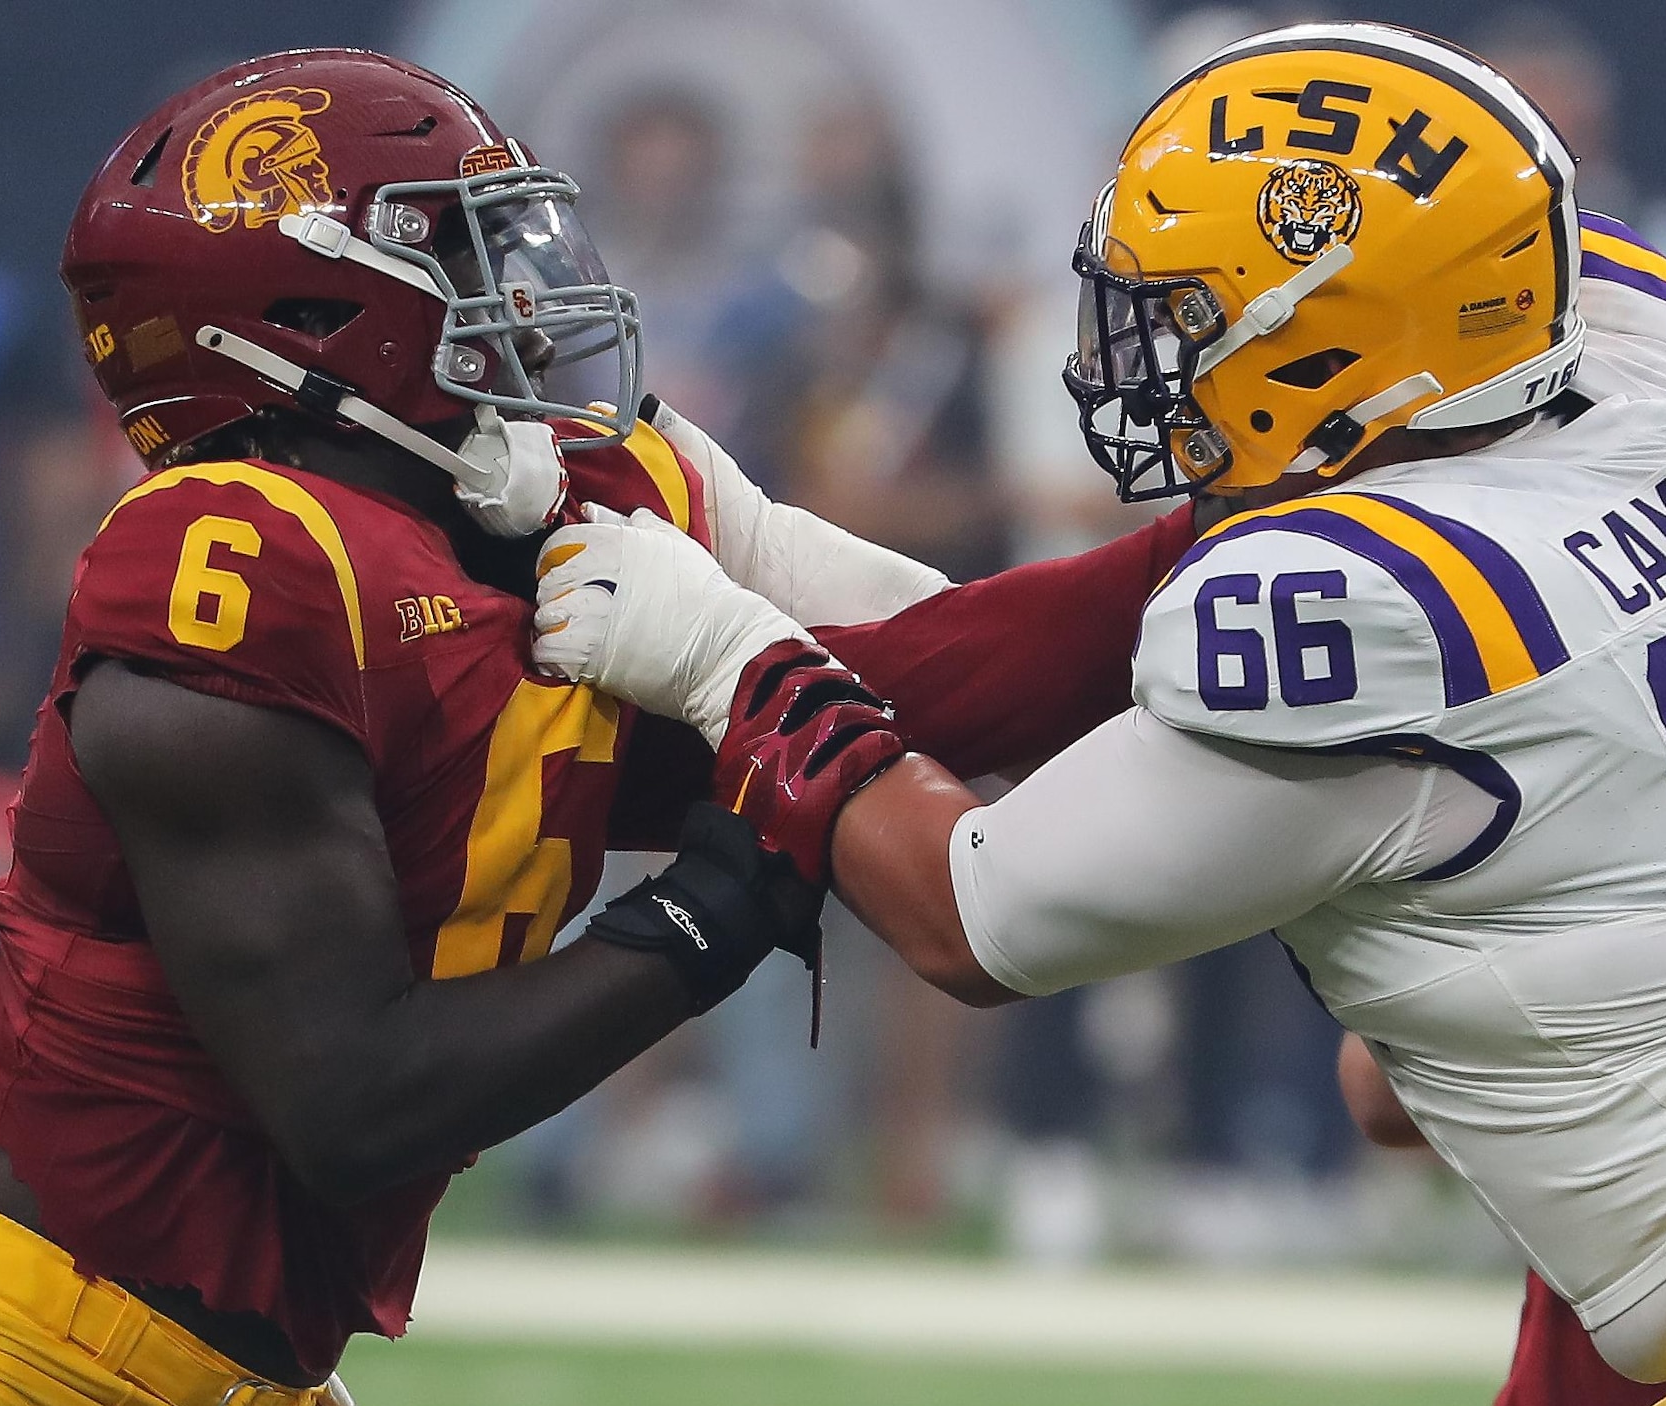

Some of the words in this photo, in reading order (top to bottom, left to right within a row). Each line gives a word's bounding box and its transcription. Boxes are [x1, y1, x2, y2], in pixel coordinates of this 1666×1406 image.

[1209, 79, 1469, 203] LSU
[84, 323, 117, 363] IG
[168, 514, 264, 653] 6
[1194, 569, 1359, 712] 66
[431, 678, 621, 981] 6
